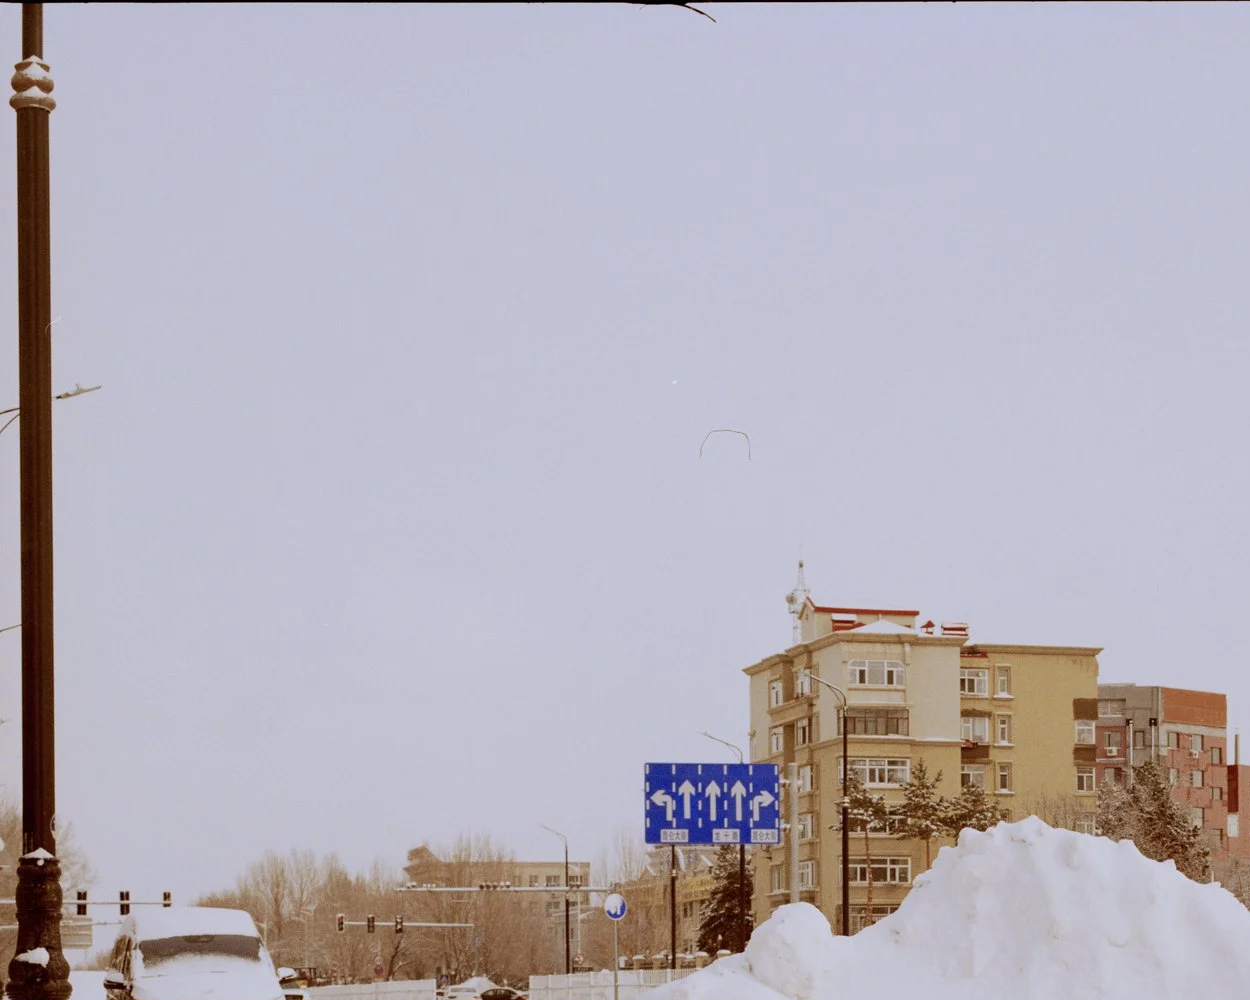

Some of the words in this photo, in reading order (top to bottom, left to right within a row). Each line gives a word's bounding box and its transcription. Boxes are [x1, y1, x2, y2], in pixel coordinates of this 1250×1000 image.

[662, 831, 687, 840] 昆仑大街
[752, 831, 777, 840] 昆仑大街
